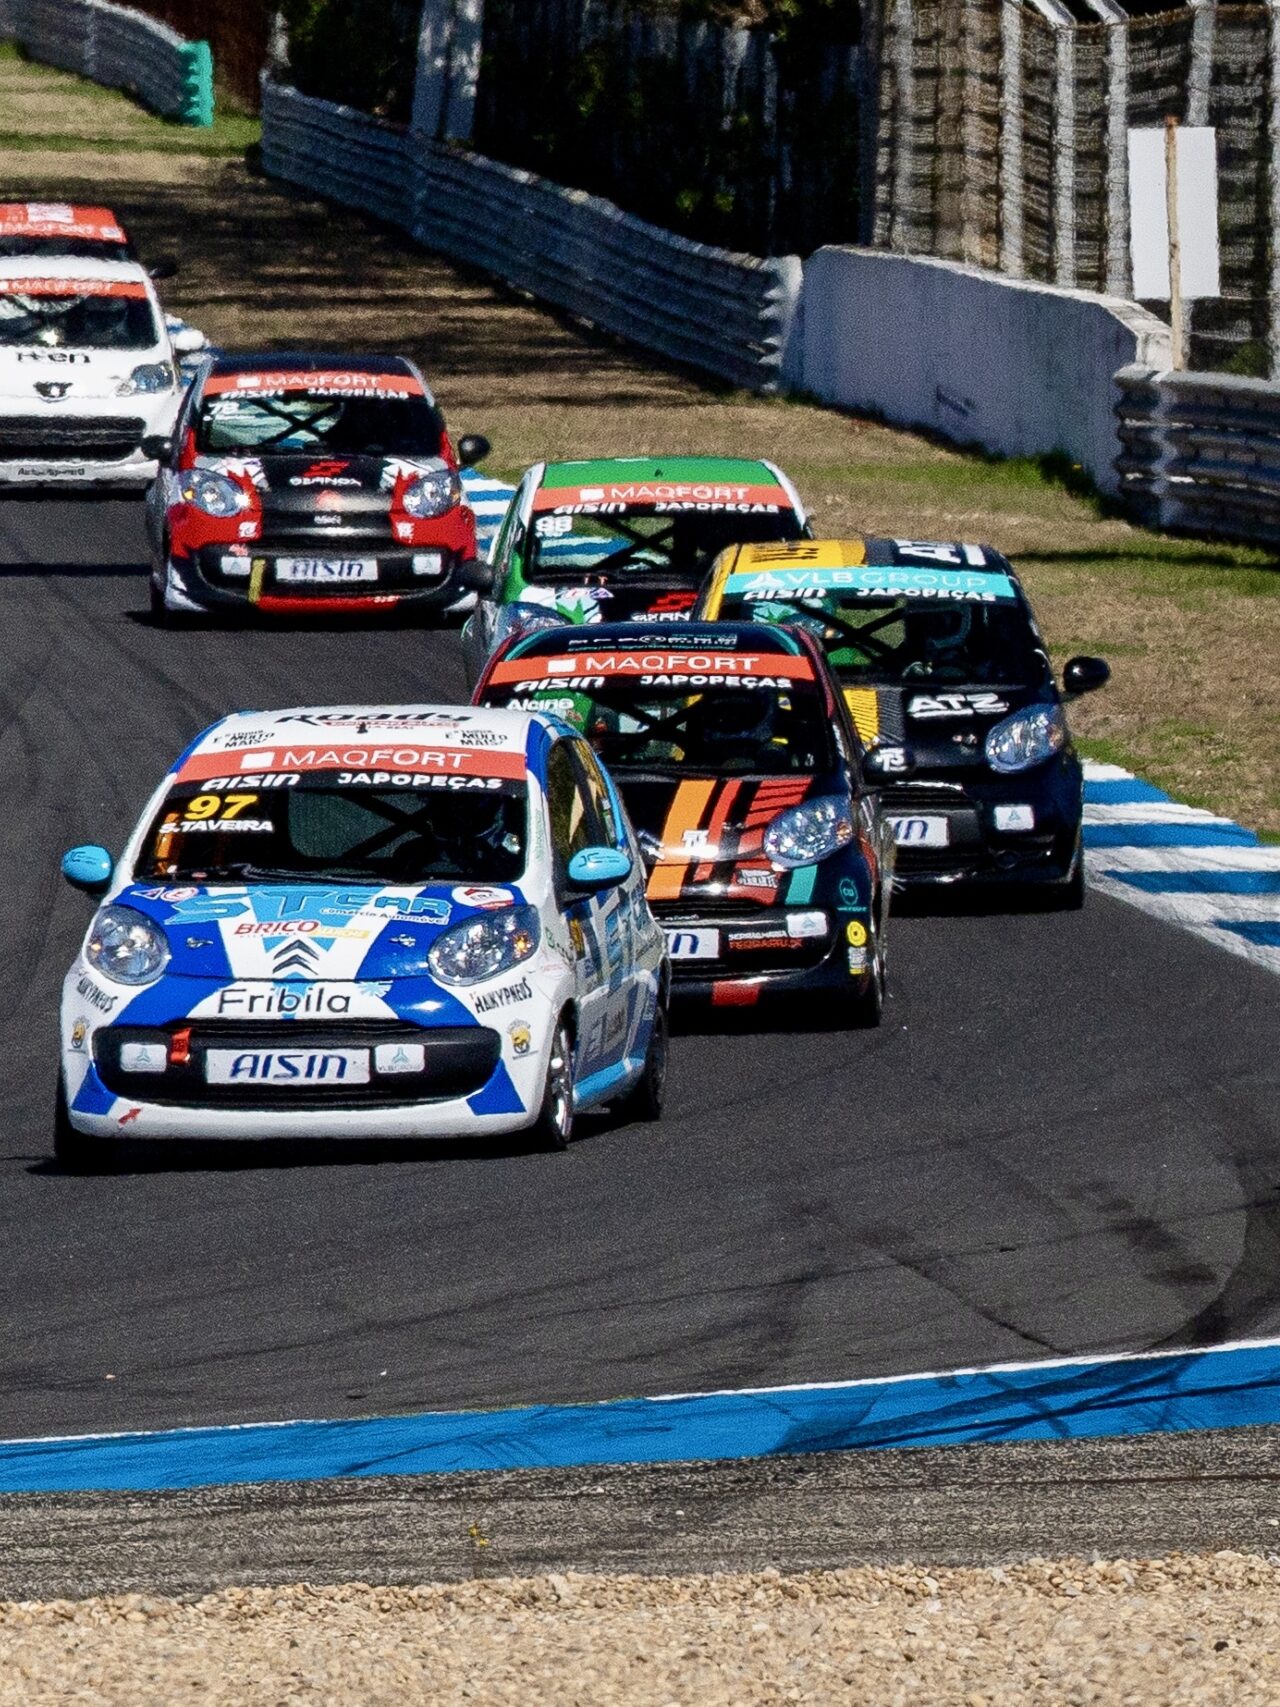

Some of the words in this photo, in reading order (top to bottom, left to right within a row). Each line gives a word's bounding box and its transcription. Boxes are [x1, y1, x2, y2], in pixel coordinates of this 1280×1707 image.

[266, 375, 382, 387] MAQFORT
[610, 486, 750, 500] MAQFORT
[743, 587, 828, 602] AISIN
[855, 587, 997, 602] JAPOPEÇAS
[585, 655, 760, 671] MAQFORT
[514, 676, 605, 692] AISIN
[640, 674, 793, 689] JAPOPEÇAS
[907, 693, 1011, 714] ATZ
[282, 750, 473, 769] MAQFORT
[200, 773, 302, 792] AISIN
[336, 772, 504, 791] JAPOPEÇAS
[183, 794, 259, 821] 97
[158, 818, 276, 835] S.TAVEIRA
[234, 920, 322, 935] BRICO
[217, 986, 352, 1014] Fribila
[229, 1053, 348, 1079] AISIN
